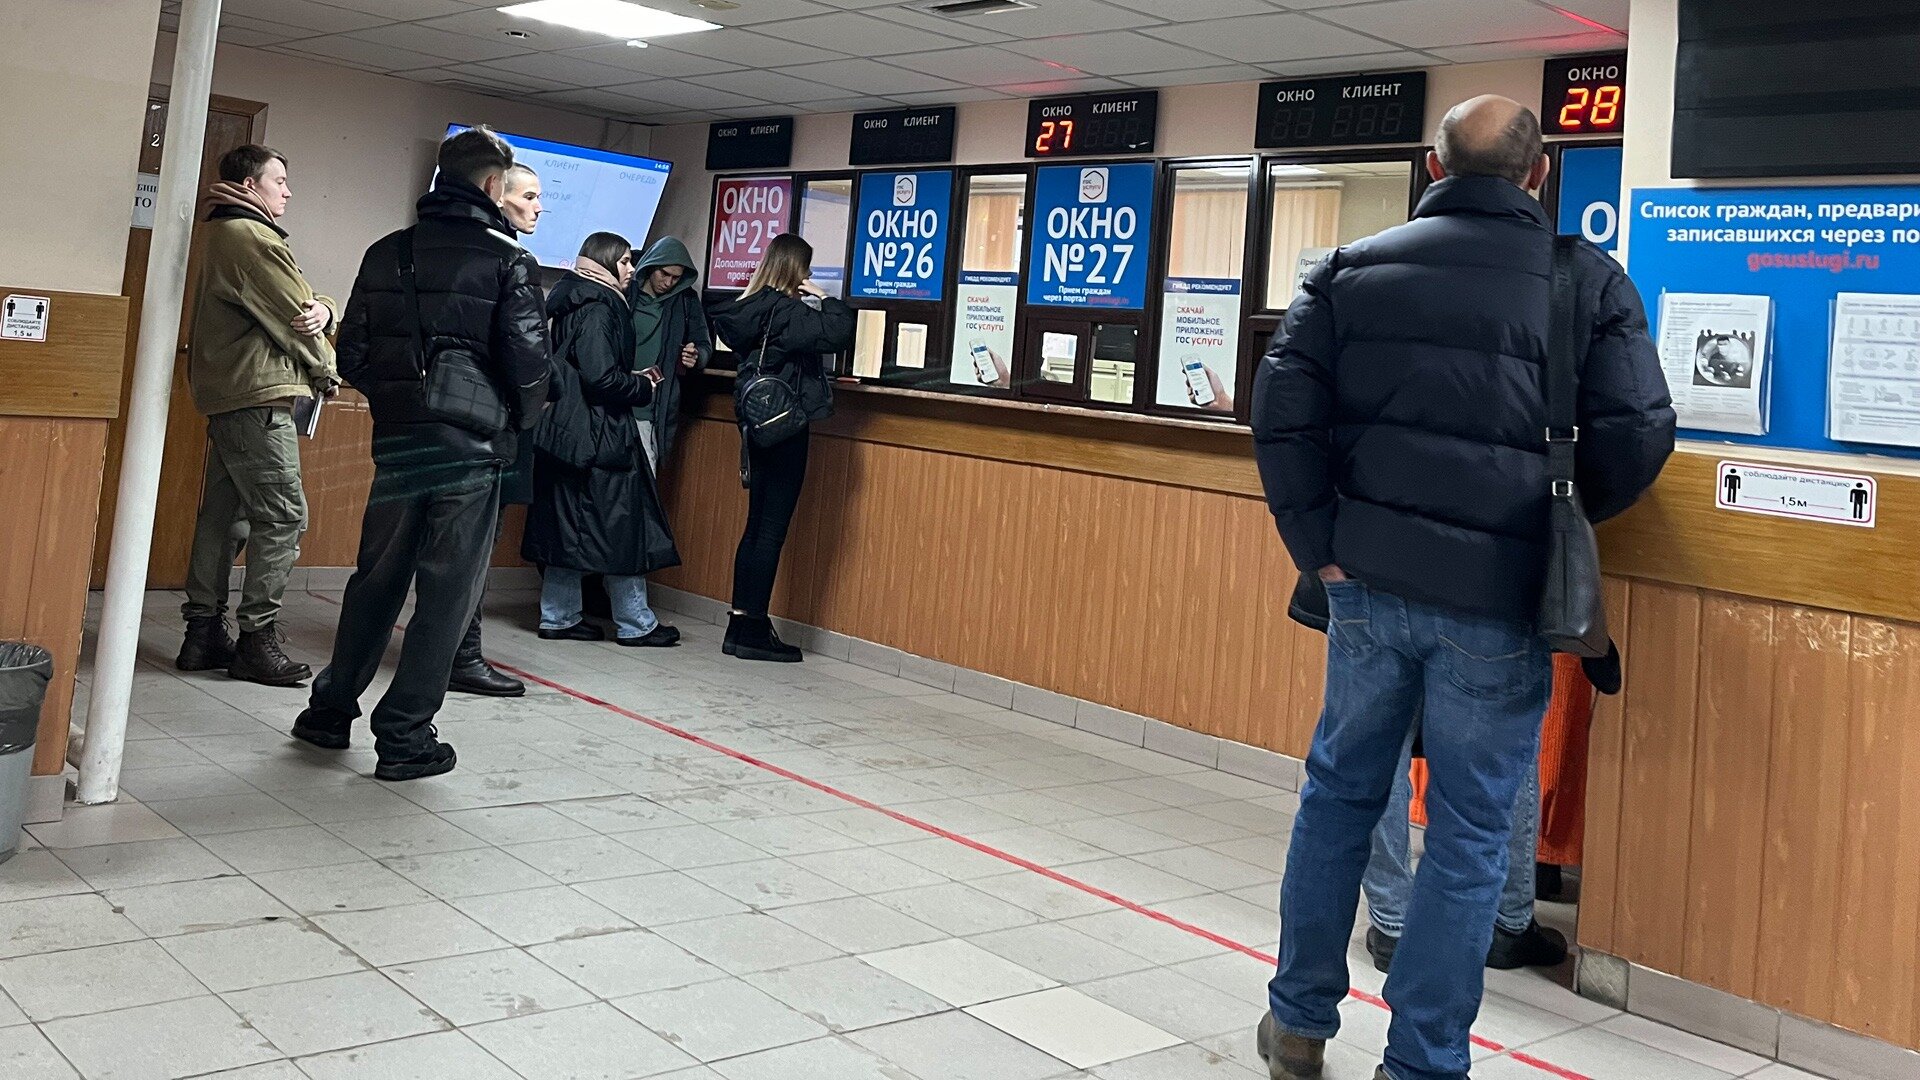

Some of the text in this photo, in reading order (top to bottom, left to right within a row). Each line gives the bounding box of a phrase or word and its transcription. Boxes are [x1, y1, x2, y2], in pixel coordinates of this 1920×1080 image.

[1568, 65, 1619, 81] ОКНО
[1276, 83, 1402, 103] ОКНО КЛИЕНТ
[1042, 101, 1138, 117] ОКНО КЛИЕНТ
[1559, 85, 1621, 126] 28
[863, 115, 940, 129] ОКНО КЛИЕНТ
[717, 125, 779, 137] ОКНО КЛИЕНТ
[1035, 120, 1073, 151] 27
[544, 159, 579, 171] КЛИЕНТ
[620, 171, 657, 185] ОЧЕРЕДЬ
[722, 186, 784, 214] ОКНО
[1640, 201, 1711, 218] Список
[1716, 204, 1813, 222] граждан,
[868, 209, 938, 239] ОКНО
[1047, 206, 1136, 240] ОКНО
[718, 219, 780, 254] №25
[1666, 228, 1815, 242] записавшихся
[1821, 229, 1886, 247] через
[863, 242, 934, 279] №26
[1043, 243, 1134, 285] №27
[1747, 250, 1880, 273] gosuslugi.ru
[875, 279, 917, 289] Прием граждан
[1058, 285, 1111, 296] Прием граждан
[1043, 294, 1062, 302] через
[1062, 295, 1087, 303] портал
[967, 305, 1002, 313] МОБИЛЬНОЕ
[1176, 306, 1205, 314] СКАЧАЙ
[966, 313, 1005, 322] ПРИЛОЖЕНИЕ
[1176, 316, 1221, 326] МОБИЛЬНОЕ
[1175, 326, 1224, 336] ПРИЛОЖЕНИЕ
[1743, 470, 1851, 488] соблюдайте дистанцию
